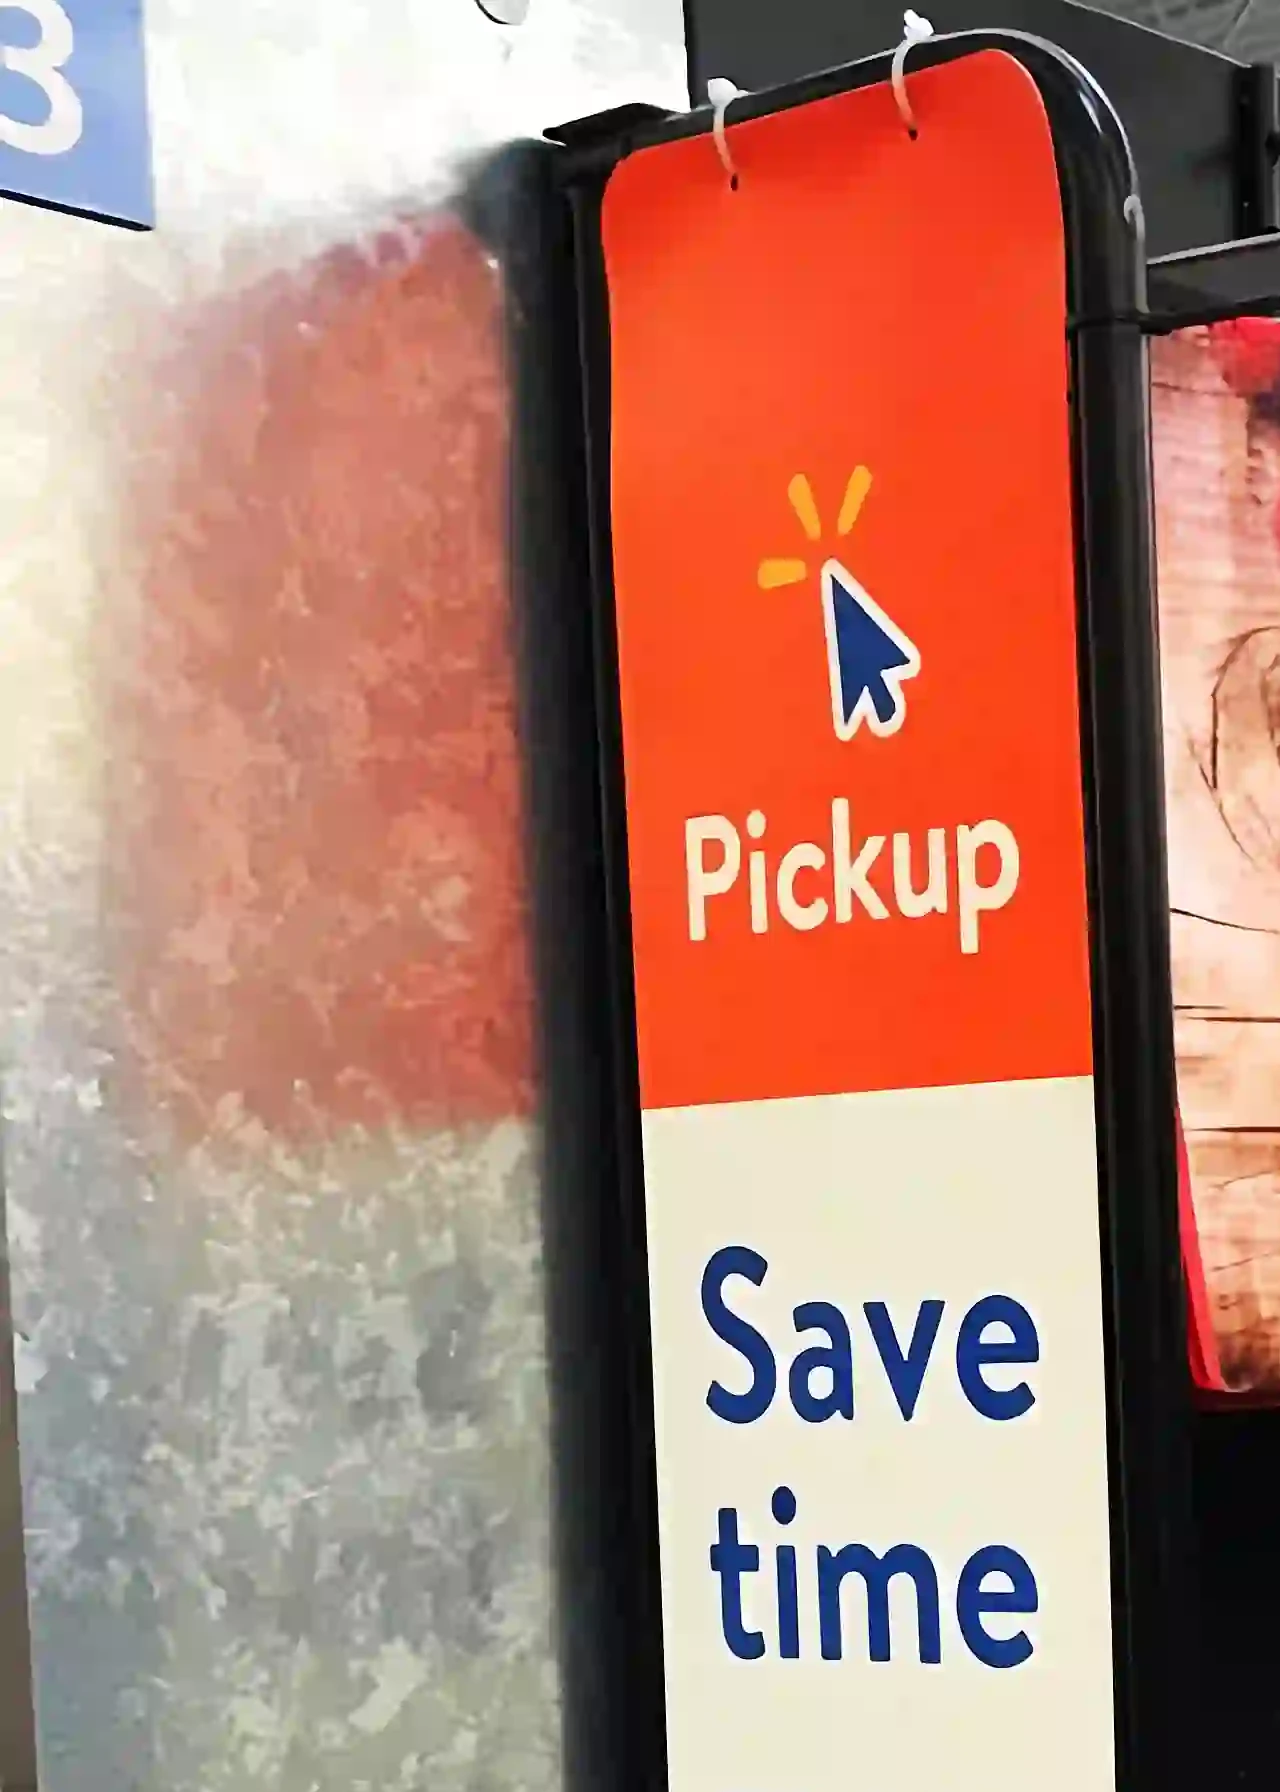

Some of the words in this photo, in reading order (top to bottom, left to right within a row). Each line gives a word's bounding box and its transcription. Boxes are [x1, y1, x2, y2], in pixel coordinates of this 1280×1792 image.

[685, 797, 1020, 955] Pickup
[701, 1245, 1040, 1424] Save
[710, 1485, 1039, 1669] time
